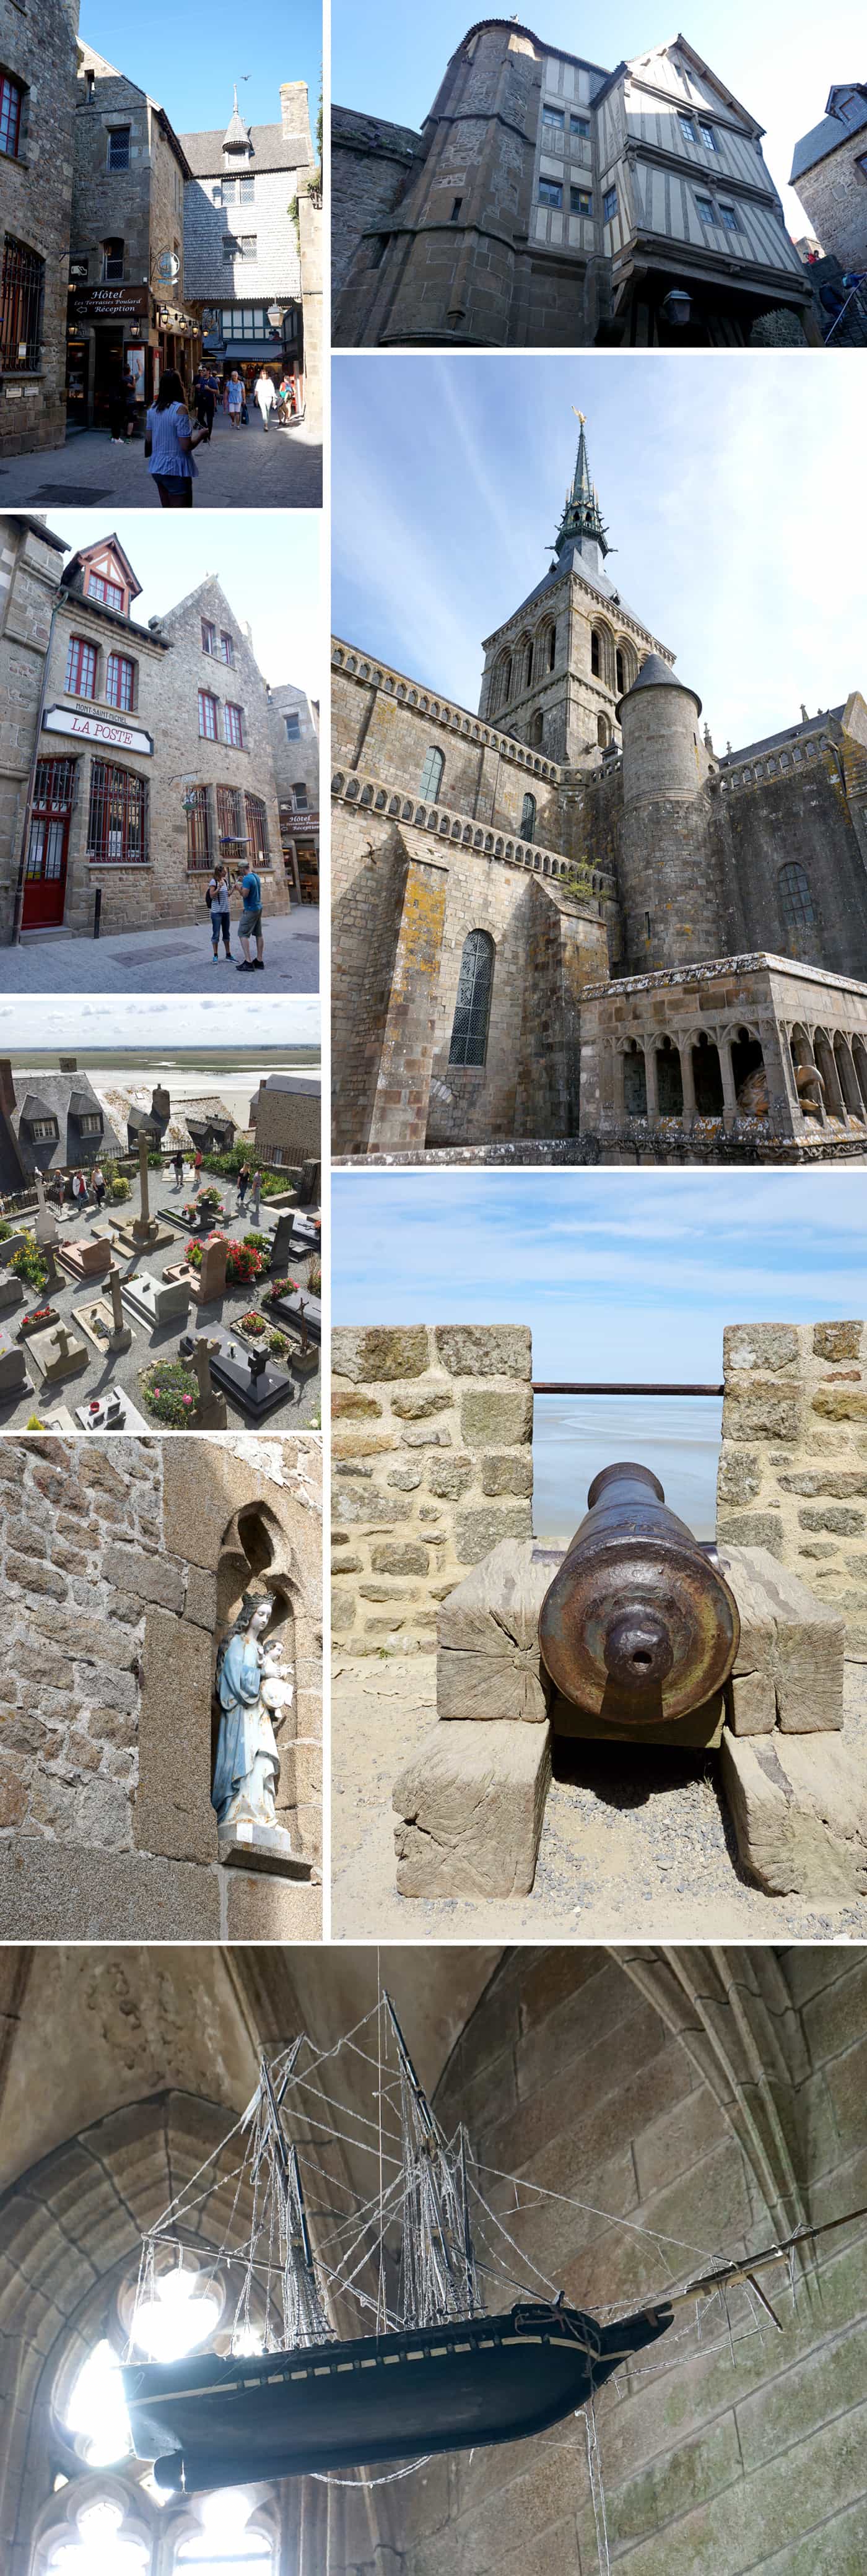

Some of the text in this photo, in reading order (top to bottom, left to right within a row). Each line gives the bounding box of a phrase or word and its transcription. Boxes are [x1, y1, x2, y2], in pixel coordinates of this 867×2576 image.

[91, 289, 126, 299] Hôtel
[94, 305, 135, 313] Réception
[71, 718, 133, 744] LA POSTE
[289, 814, 312, 822] Hôtel
